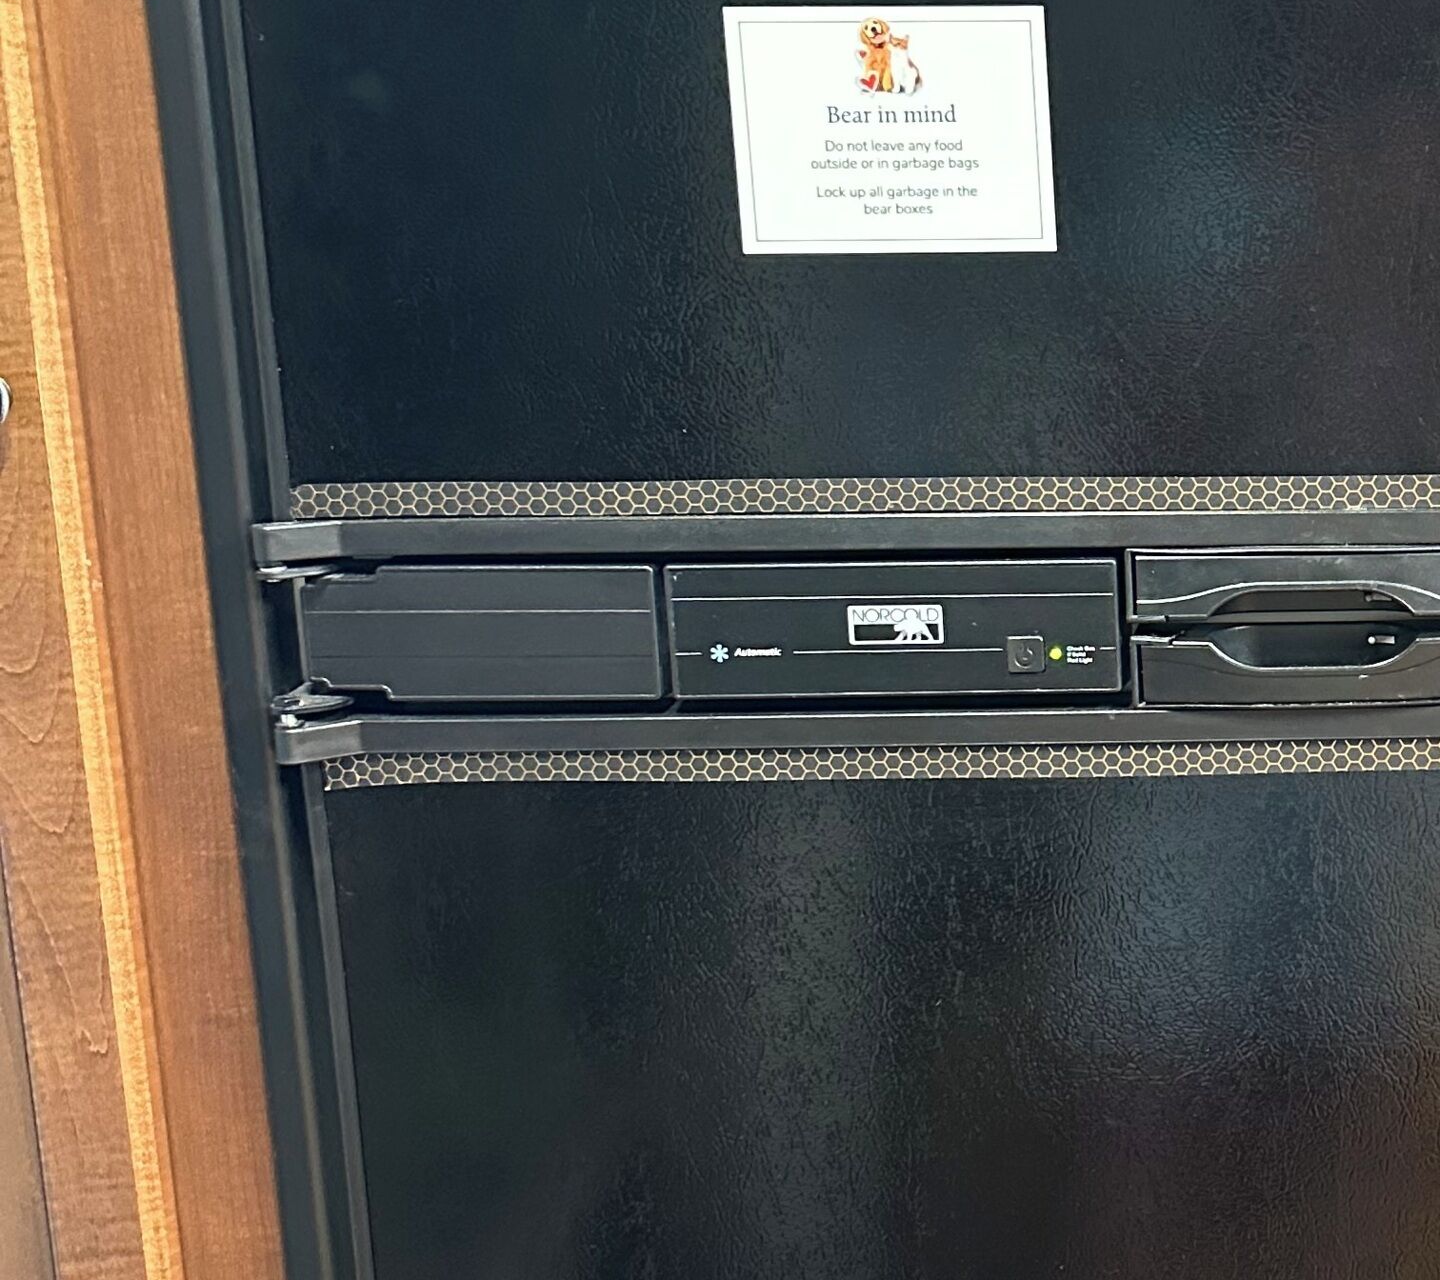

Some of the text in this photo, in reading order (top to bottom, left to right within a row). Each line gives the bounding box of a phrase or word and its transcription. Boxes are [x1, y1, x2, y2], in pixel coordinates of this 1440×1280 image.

[827, 104, 957, 124] Bear in mind
[824, 139, 963, 153] Do not leave any food
[811, 156, 979, 171] outside or in garbage bags
[816, 185, 978, 200] Lock up all garbage in the
[863, 203, 933, 215] bear boxes
[852, 607, 939, 623] NORCOLD
[734, 646, 782, 658] Automatic
